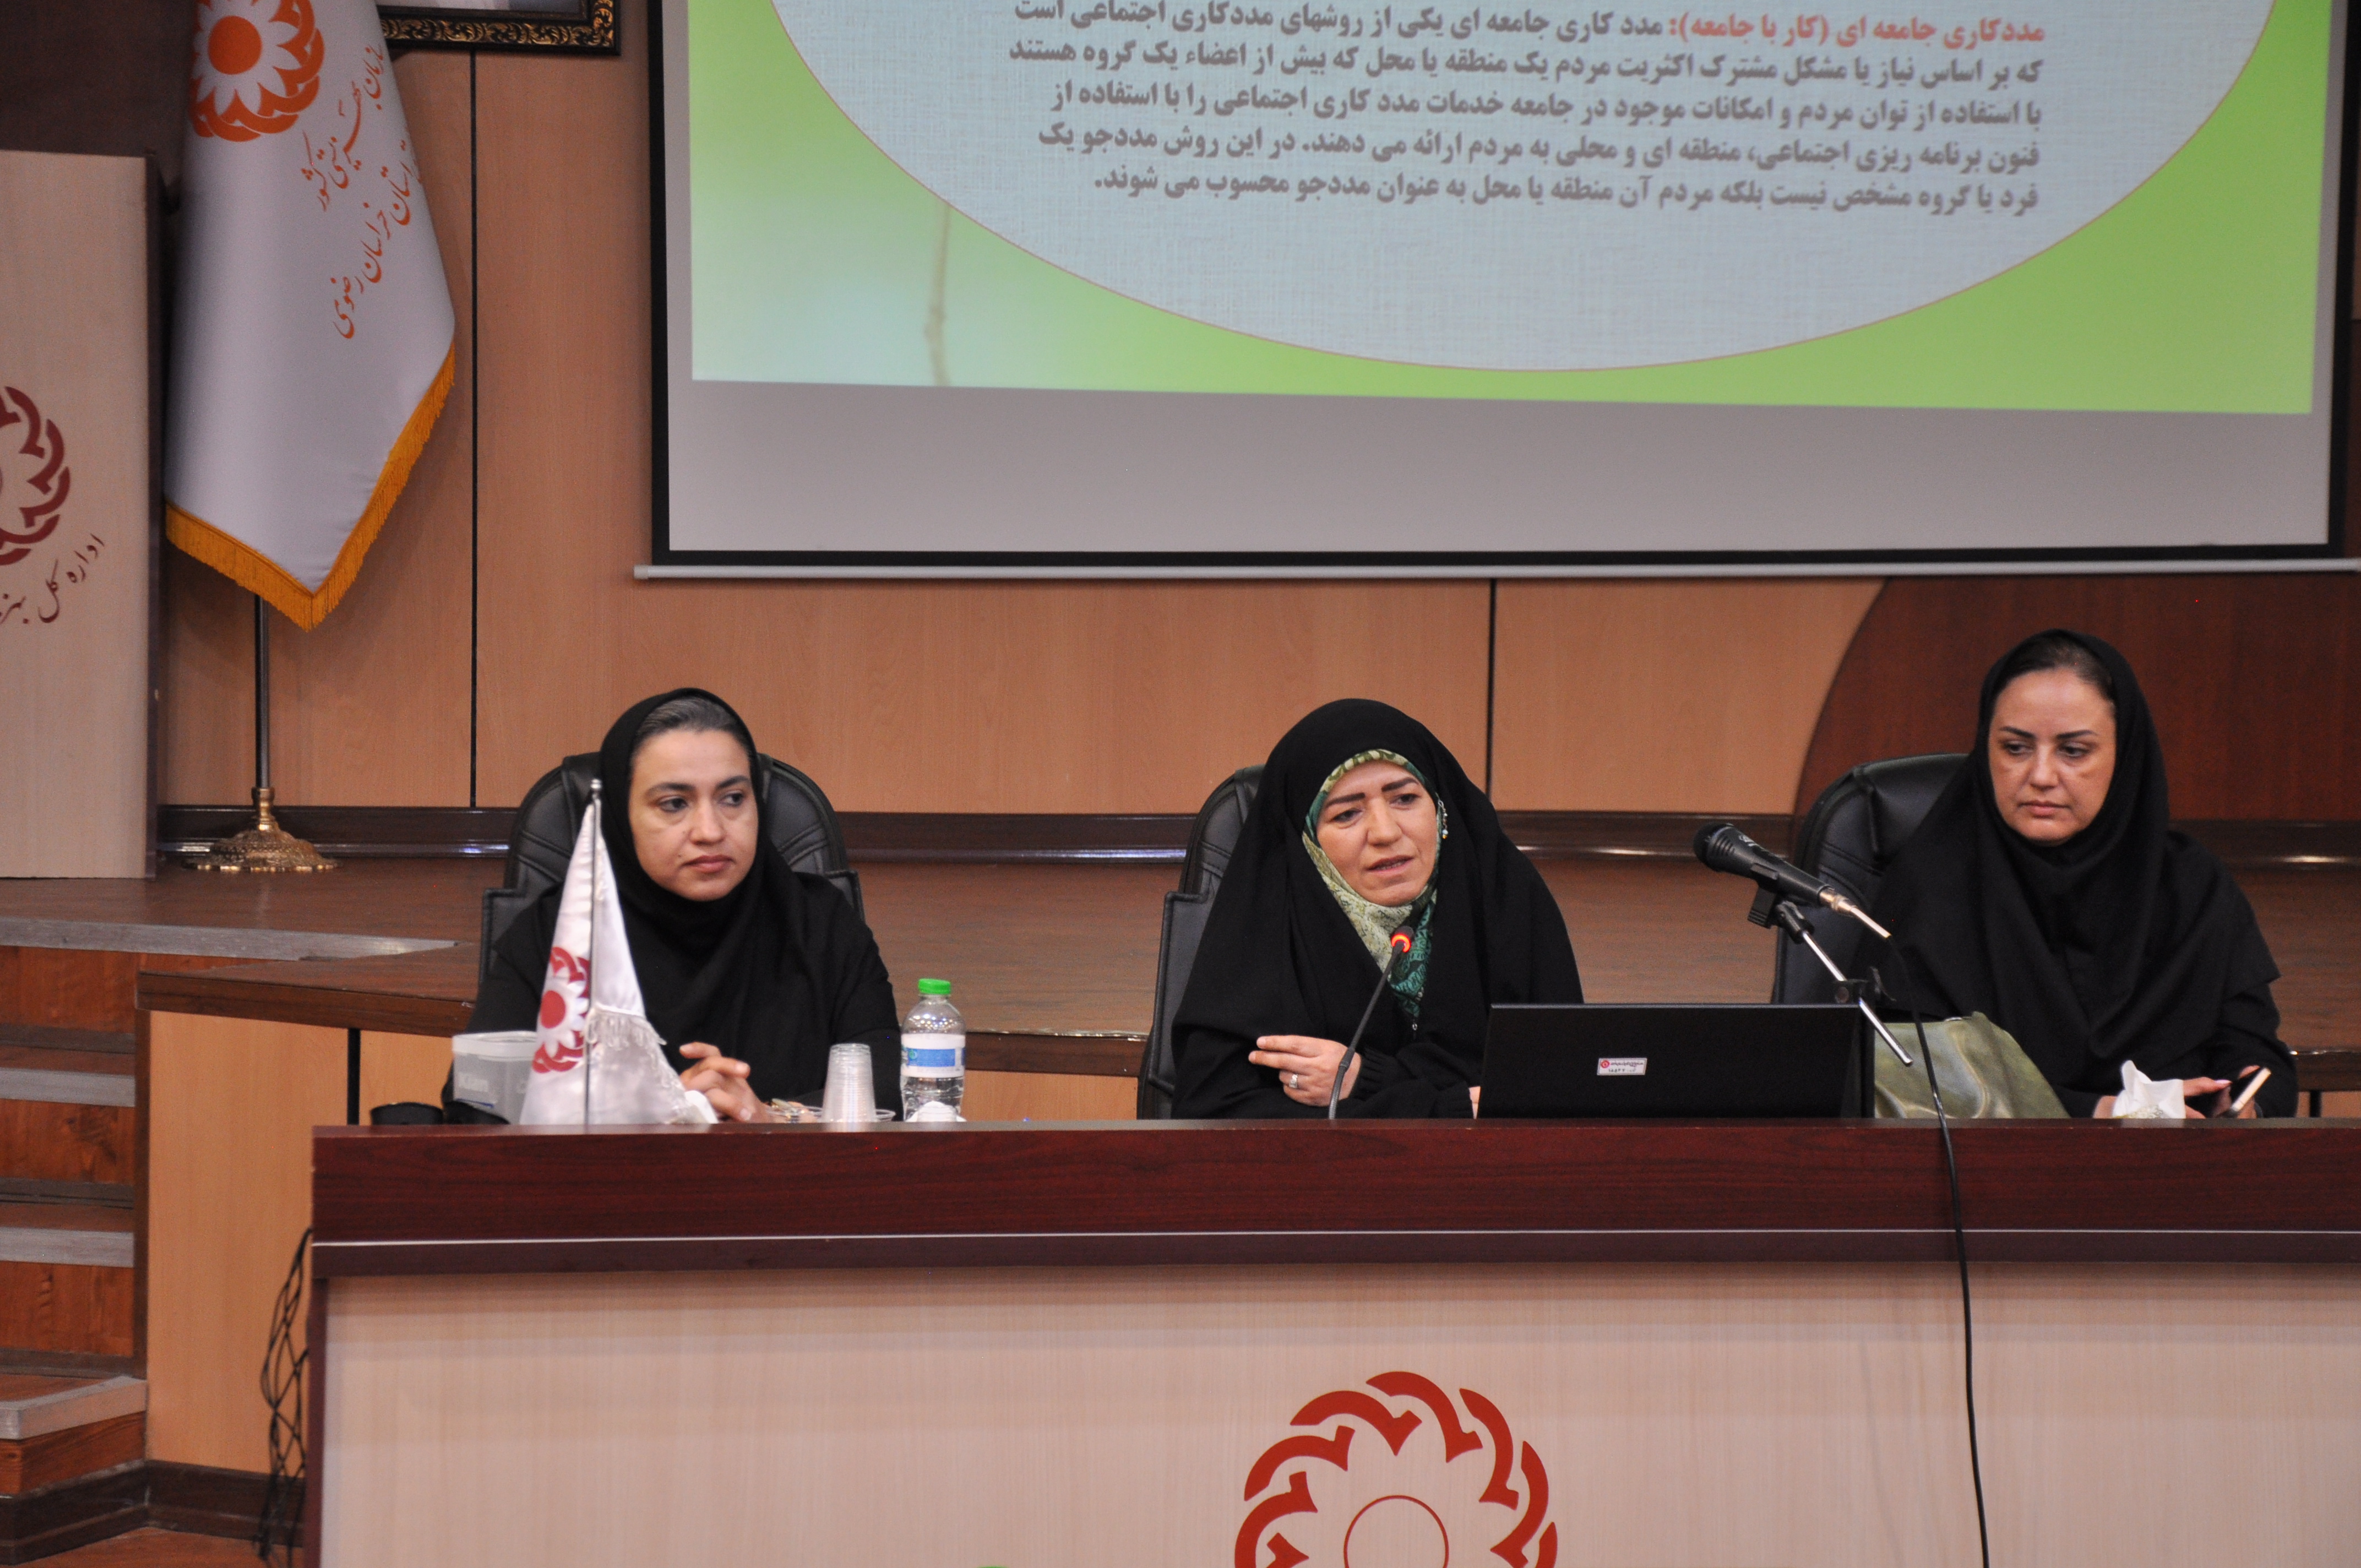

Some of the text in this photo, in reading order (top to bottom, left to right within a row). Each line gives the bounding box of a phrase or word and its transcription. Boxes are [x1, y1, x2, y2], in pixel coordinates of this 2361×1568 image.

[1015, 0, 2044, 50] مددکاری جامعه ای (کار با جامعه): مدد کاری جامعه ای یکی از روشهای مددکاری اجتماعی است
[1010, 40, 2043, 90] که بر اساس نیاز یا مشکل مشترک اکثریت مردم یک منطقه یا محل که بیش از اعضاء یک گروه هستند
[1051, 80, 2041, 131] با استفاده از توان مردم و امکانات موجود در جامعه خدمات مدد کاری اجتماعی را با استفاده از
[1039, 122, 2039, 175] فنون برنامه ریزی اجتماعی، منطقه ای و محلی به مردم ارائه می دهند. در این روش مددجو یک
[1095, 165, 2038, 216] فرد یا گروه مشخص نیست بلکه مردم آن منطقه یا محل به عنوان مددجو محسوب می شوند.
[361, 202, 391, 284] خراسان
[330, 276, 365, 339] رضوی
[38, 559, 60, 623] کل
